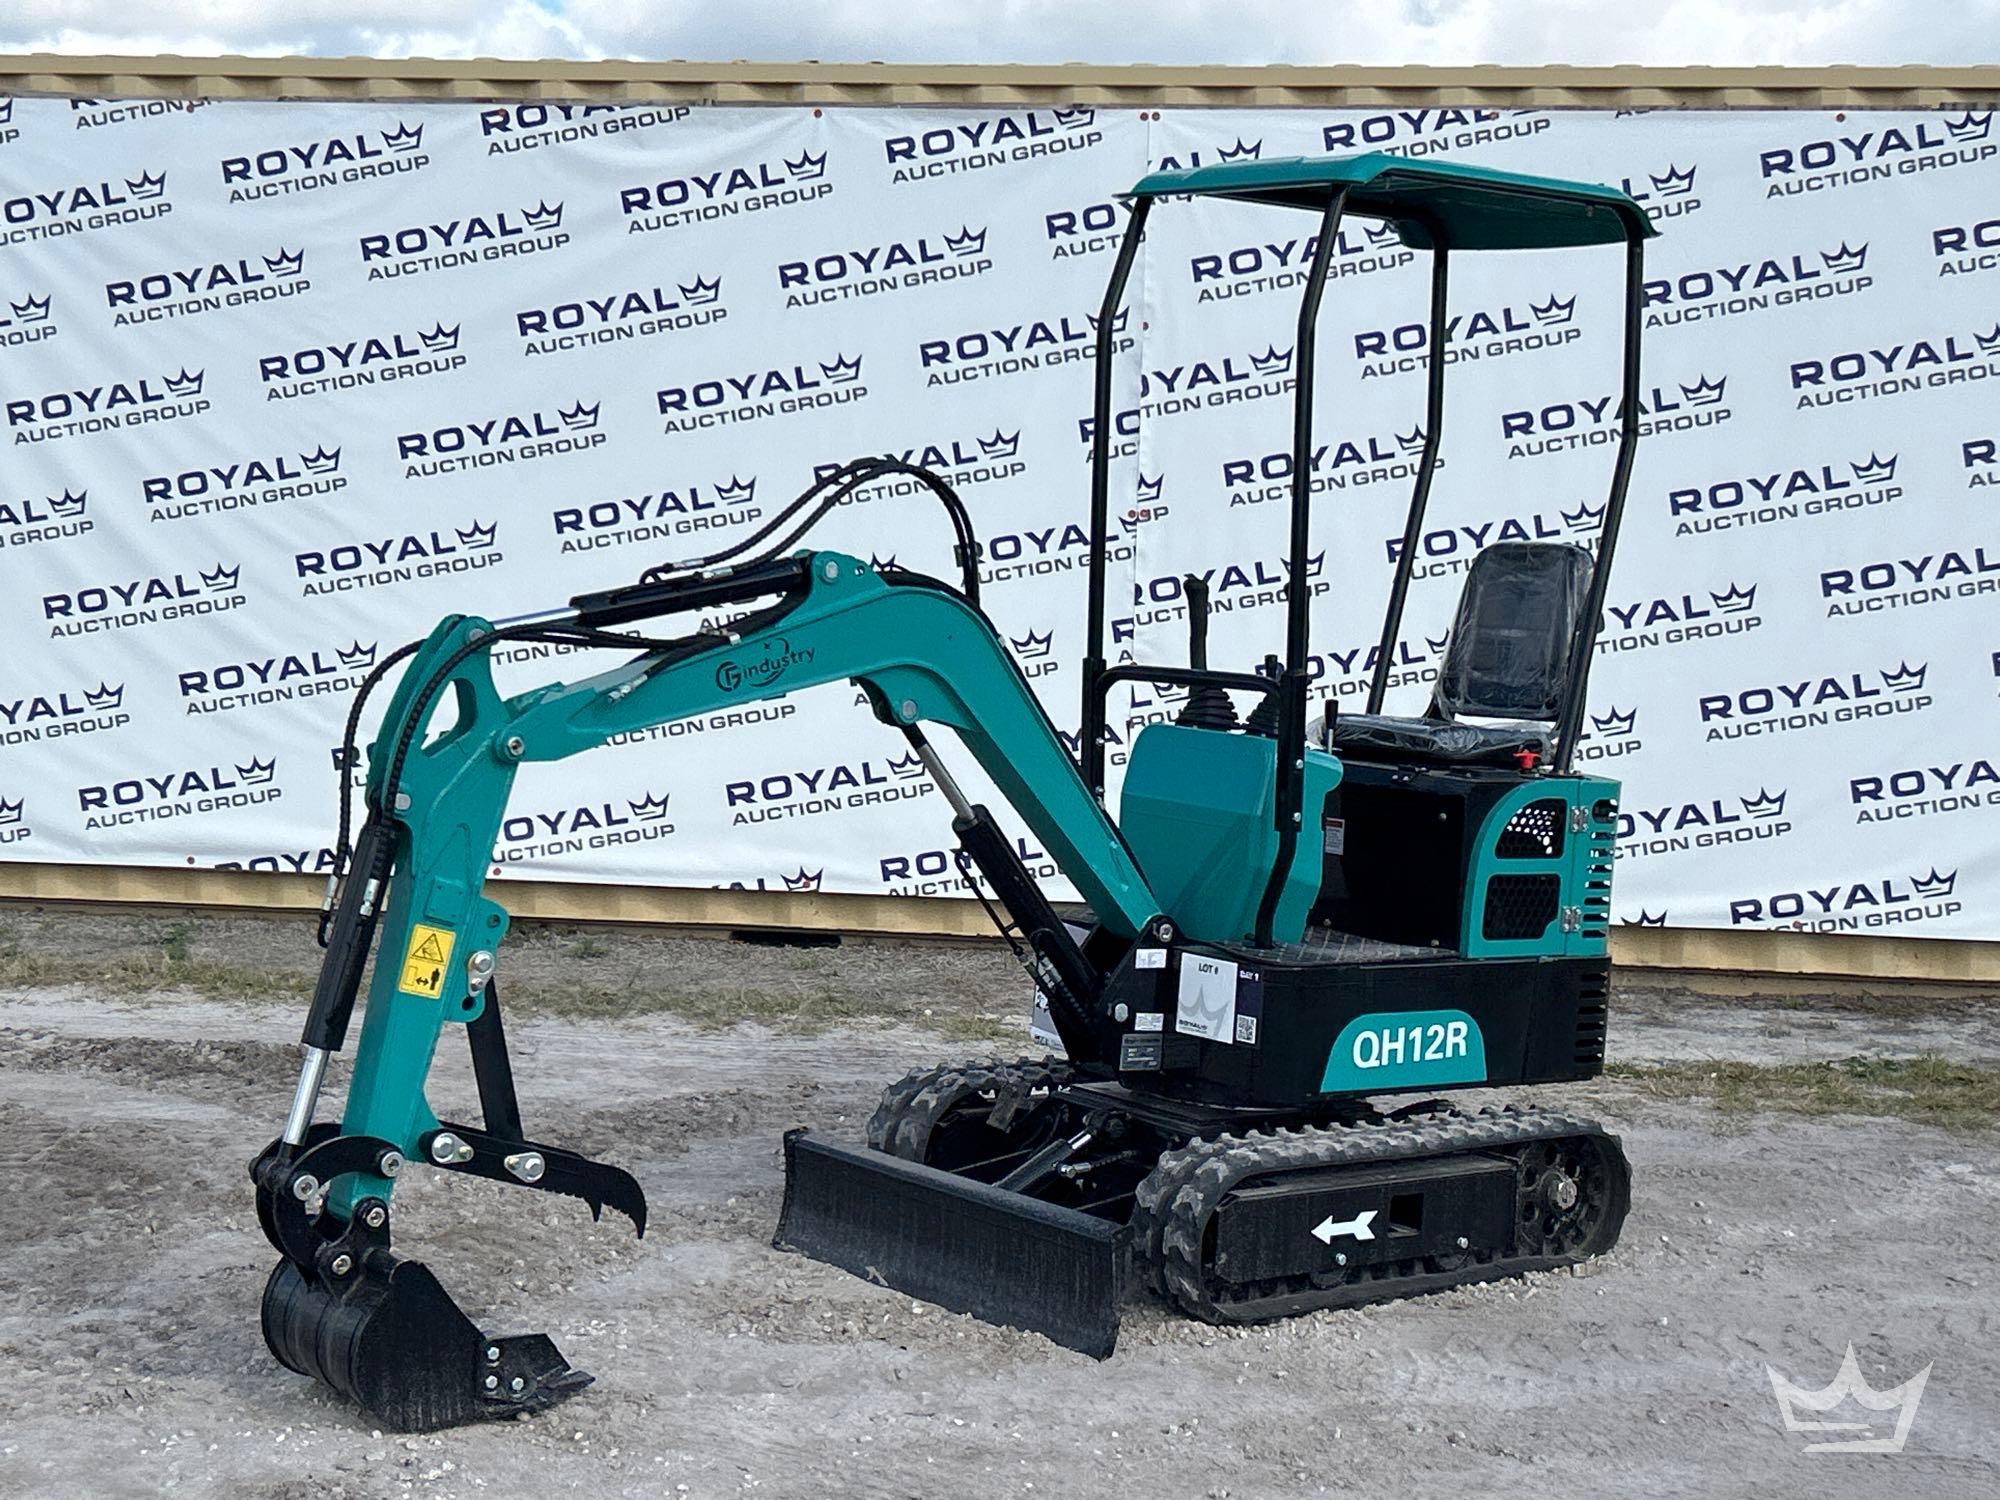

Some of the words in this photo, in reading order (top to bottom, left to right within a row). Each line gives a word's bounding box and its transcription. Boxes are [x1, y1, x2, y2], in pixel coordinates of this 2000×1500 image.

[488, 123, 598, 156] AUCTION
[603, 107, 690, 134] GROUP
[885, 112, 1054, 164] ROYAL
[1455, 119, 1550, 148] GROUP
[1760, 124, 1944, 178] ROYAL
[221, 135, 382, 184] ROYAL
[230, 172, 337, 204] AUCTION
[343, 155, 429, 182] GROUP
[893, 151, 1006, 184] AUCTION
[1012, 132, 1102, 161] GROUP
[1767, 164, 1891, 199] AUCTION
[1898, 145, 1997, 174] GROUP
[4, 183, 126, 223] OYAL
[620, 164, 785, 214] ROYAL
[629, 201, 739, 234] AUCTION
[745, 183, 833, 211] GROUP
[0, 219, 83, 246] CTION
[88, 203, 172, 229] GROUP
[360, 213, 523, 262] ROYAL
[368, 250, 478, 281] AUCTION
[483, 233, 570, 260] GROUP
[778, 239, 944, 289] ROYAL
[106, 260, 265, 307] ROYAL
[114, 296, 221, 327] AUCTION
[226, 280, 310, 306] GROUP
[786, 277, 898, 309] AUCTION
[904, 259, 992, 287] GROUP
[1642, 256, 1821, 308] ROYAL
[1646, 295, 1768, 329] AUCTION
[1775, 276, 1872, 305] GROUP
[517, 288, 680, 337] ROYAL
[525, 325, 634, 356] AUCTION
[639, 308, 727, 335] GROUP
[0, 326, 57, 347] ROUP
[259, 335, 420, 382] ROYAL
[920, 318, 1087, 367] ROYAL
[1361, 346, 1480, 379] AUCTON
[1486, 328, 1581, 356] GROUP
[267, 371, 375, 401] AUCTION
[380, 355, 466, 381] GROUP
[927, 355, 1039, 387] AUCTION
[1141, 358, 1250, 398] YAL
[1790, 337, 1974, 389] ROYAL
[6, 380, 165, 426] ROYAL
[657, 366, 820, 415] ROYAL
[1141, 391, 1201, 418] TION
[1797, 376, 1921, 410] AUCTION
[1928, 363, 2000, 387] GRO
[15, 416, 120, 445] AUCTION
[126, 400, 210, 425] GROUP
[665, 403, 774, 434] AUCTION
[780, 387, 867, 413] GROUP
[1637, 409, 1731, 436] GROUP
[397, 413, 559, 460] ROYAL
[406, 449, 514, 479] AUCTION
[520, 433, 606, 459] GROUP
[143, 457, 301, 503] ROYAL
[814, 441, 978, 487] RYAL
[151, 493, 257, 522] AUCTION
[263, 478, 347, 503] GROUP
[553, 488, 715, 534] ROYAL
[828, 480, 932, 507] UCTION
[1230, 475, 1346, 507] AUCON
[1669, 466, 1850, 516] ROYAL
[1676, 504, 1798, 537] AUCTION
[1805, 487, 1902, 515] GROUP
[10, 521, 94, 545] GROUP
[561, 524, 670, 554] AUCTION
[675, 508, 762, 534] GROUP
[295, 532, 456, 577] ROYAL
[303, 568, 411, 597] AUCTION
[417, 553, 503, 577] GROUP
[961, 557, 1072, 587] UCTION
[1820, 548, 2000, 597] ROYAL
[43, 575, 200, 619] ROYAL
[51, 610, 157, 638] AUCTION
[162, 595, 246, 619] GROUP
[1239, 582, 1330, 609] GROP
[1597, 595, 1710, 635] YAL
[1827, 586, 1951, 618] AUCTION
[1595, 633, 1659, 653] TION
[1666, 617, 1761, 643] GROUP
[178, 652, 337, 696] ROYAL
[187, 687, 293, 715] AUCTION
[298, 675, 369, 697] GROU
[0, 693, 84, 725] YAL
[1700, 674, 1880, 722] ROYAL
[1706, 711, 1828, 742] AUCTION
[1835, 696, 1932, 722] GROUP
[46, 714, 130, 738] GROUP
[605, 718, 704, 747] UCTION
[710, 705, 795, 729] GROUP
[1575, 740, 1641, 762] OUP
[78, 768, 236, 811] ROYAL
[726, 762, 887, 807] ROYAL
[733, 797, 842, 826] AUCTION
[848, 783, 934, 807] GROUP
[1850, 760, 2000, 804] ROYA
[86, 802, 191, 830] AUCTION
[197, 788, 281, 812] GROUP
[504, 804, 629, 841] OYAL
[1614, 800, 1740, 840] OYAL
[1857, 794, 1980, 824] AUCTION
[494, 838, 583, 863] UCTION
[589, 824, 675, 848] GROUP
[1696, 822, 1791, 847] GROUP
[1730, 880, 1910, 925] ROYAL
[1865, 902, 1961, 927] GROUP
[1352, 1020, 1469, 1069] QH12R
